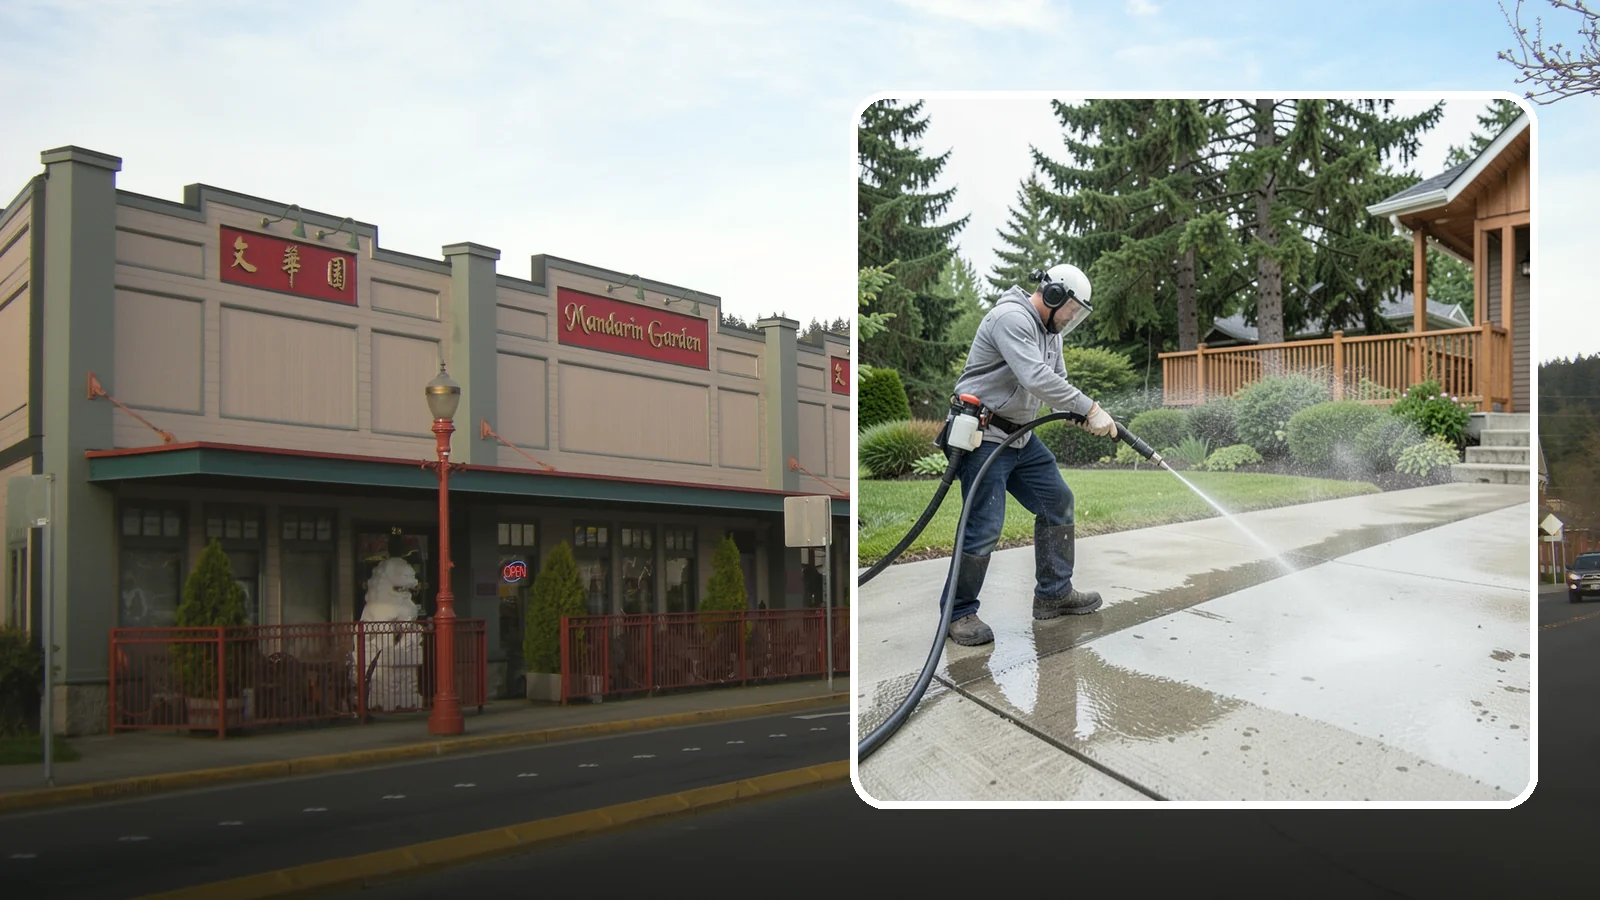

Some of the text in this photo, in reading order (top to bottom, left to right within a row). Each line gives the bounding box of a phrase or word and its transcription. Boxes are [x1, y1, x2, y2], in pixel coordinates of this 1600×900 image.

[231, 235, 346, 291] 文華園
[564, 302, 701, 351] Mandarin Garden
[834, 363, 847, 386] 文
[503, 565, 527, 578] OPEN
